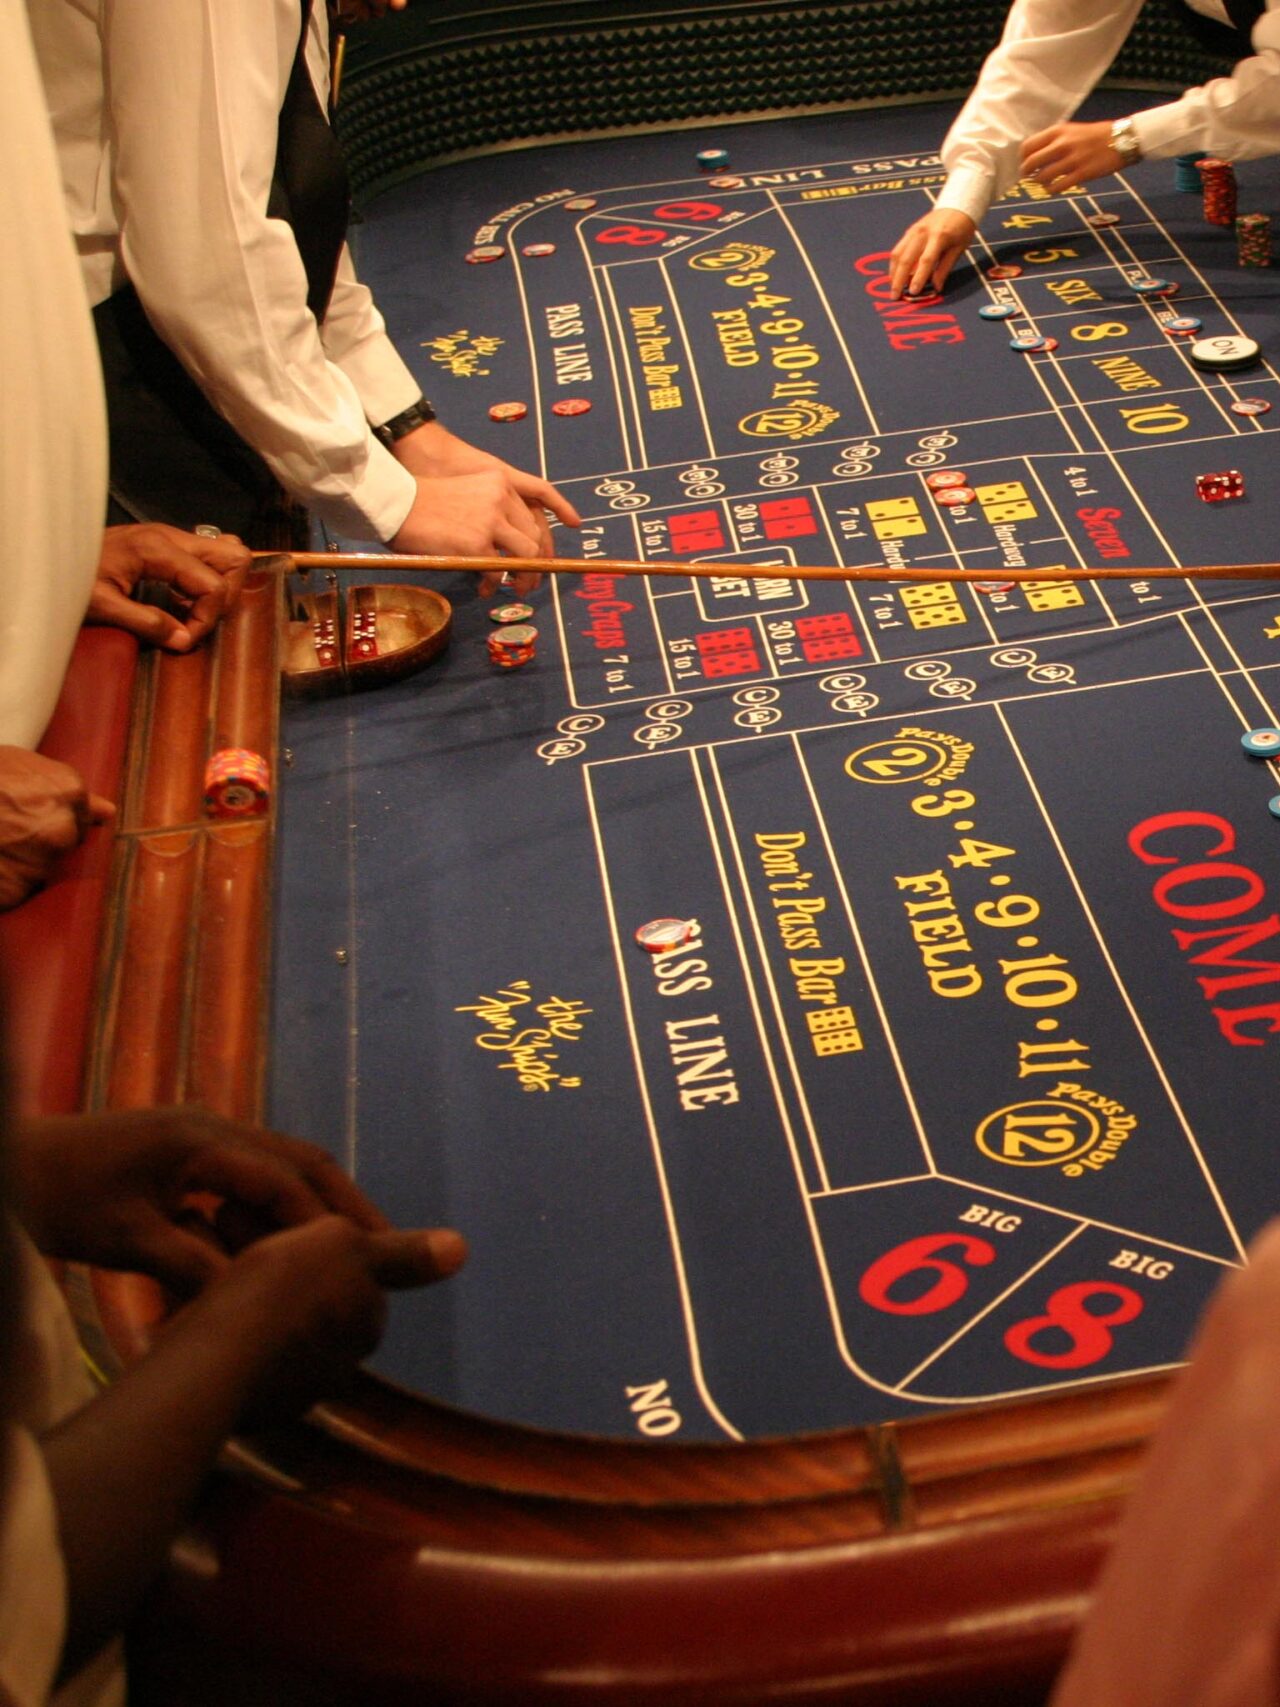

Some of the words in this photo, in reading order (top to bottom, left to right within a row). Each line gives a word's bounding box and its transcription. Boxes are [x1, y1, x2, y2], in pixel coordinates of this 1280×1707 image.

[653, 201, 723, 221] 6
[1002, 214, 1053, 229] 4
[595, 225, 668, 246] 8
[701, 252, 744, 267] 2
[1023, 249, 1079, 264] 5
[1044, 278, 1104, 305] SIX
[545, 303, 585, 338] PASS
[629, 306, 668, 336] Don't
[711, 308, 760, 367] FIELD
[1070, 322, 1129, 341] 8
[636, 336, 671, 363] Pass
[1212, 339, 1240, 355] ON
[553, 343, 593, 385] LINE
[642, 364, 679, 387] Bar
[1091, 356, 1163, 392] NINE
[755, 412, 804, 433] 12
[1118, 403, 1190, 434] 10
[1064, 465, 1087, 476] 4
[1070, 477, 1089, 488] to
[733, 504, 759, 520] 30
[836, 507, 860, 515] 7
[581, 526, 604, 534] 7
[641, 519, 668, 533] 15
[737, 522, 756, 534] to
[840, 519, 859, 531] to
[1076, 506, 1131, 559] Seven
[582, 537, 600, 550] to
[645, 535, 665, 546] to
[742, 534, 764, 542] 1
[845, 531, 868, 540] 1
[584, 551, 606, 559] 1
[648, 547, 671, 555] 1
[992, 524, 1026, 567] Hardway
[1130, 581, 1150, 594] to
[869, 593, 894, 602] 7
[1138, 595, 1162, 604] 1
[874, 606, 894, 620] to
[994, 605, 1020, 613] 1
[581, 600, 635, 649] Craps
[767, 621, 796, 640] 30
[879, 621, 904, 630] 1
[668, 637, 697, 653] 15
[775, 642, 798, 655] to
[603, 655, 629, 664] 7
[673, 655, 695, 669] to
[779, 656, 804, 666] 1
[606, 669, 628, 683] to
[677, 670, 702, 680] 1
[609, 683, 634, 693] 1
[862, 747, 928, 776] 2
[911, 789, 976, 817] 3
[755, 831, 814, 892] Don't
[948, 838, 1016, 868] 4
[974, 894, 1040, 928] 9
[772, 897, 826, 950] Pass
[894, 869, 983, 998] FIELD
[789, 957, 845, 1005] Bar
[998, 953, 1078, 1008] 10
[665, 1014, 740, 1111] LINE
[1046, 1081, 1125, 1116] Pays
[1003, 1113, 1078, 1157] 12
[1062, 1114, 1137, 1177] Double
[958, 1204, 1022, 1234] BIG
[857, 1232, 997, 1316] 6
[1108, 1250, 1174, 1280] BIG
[1003, 1280, 1144, 1370] 8
[625, 1379, 682, 1438] NO
